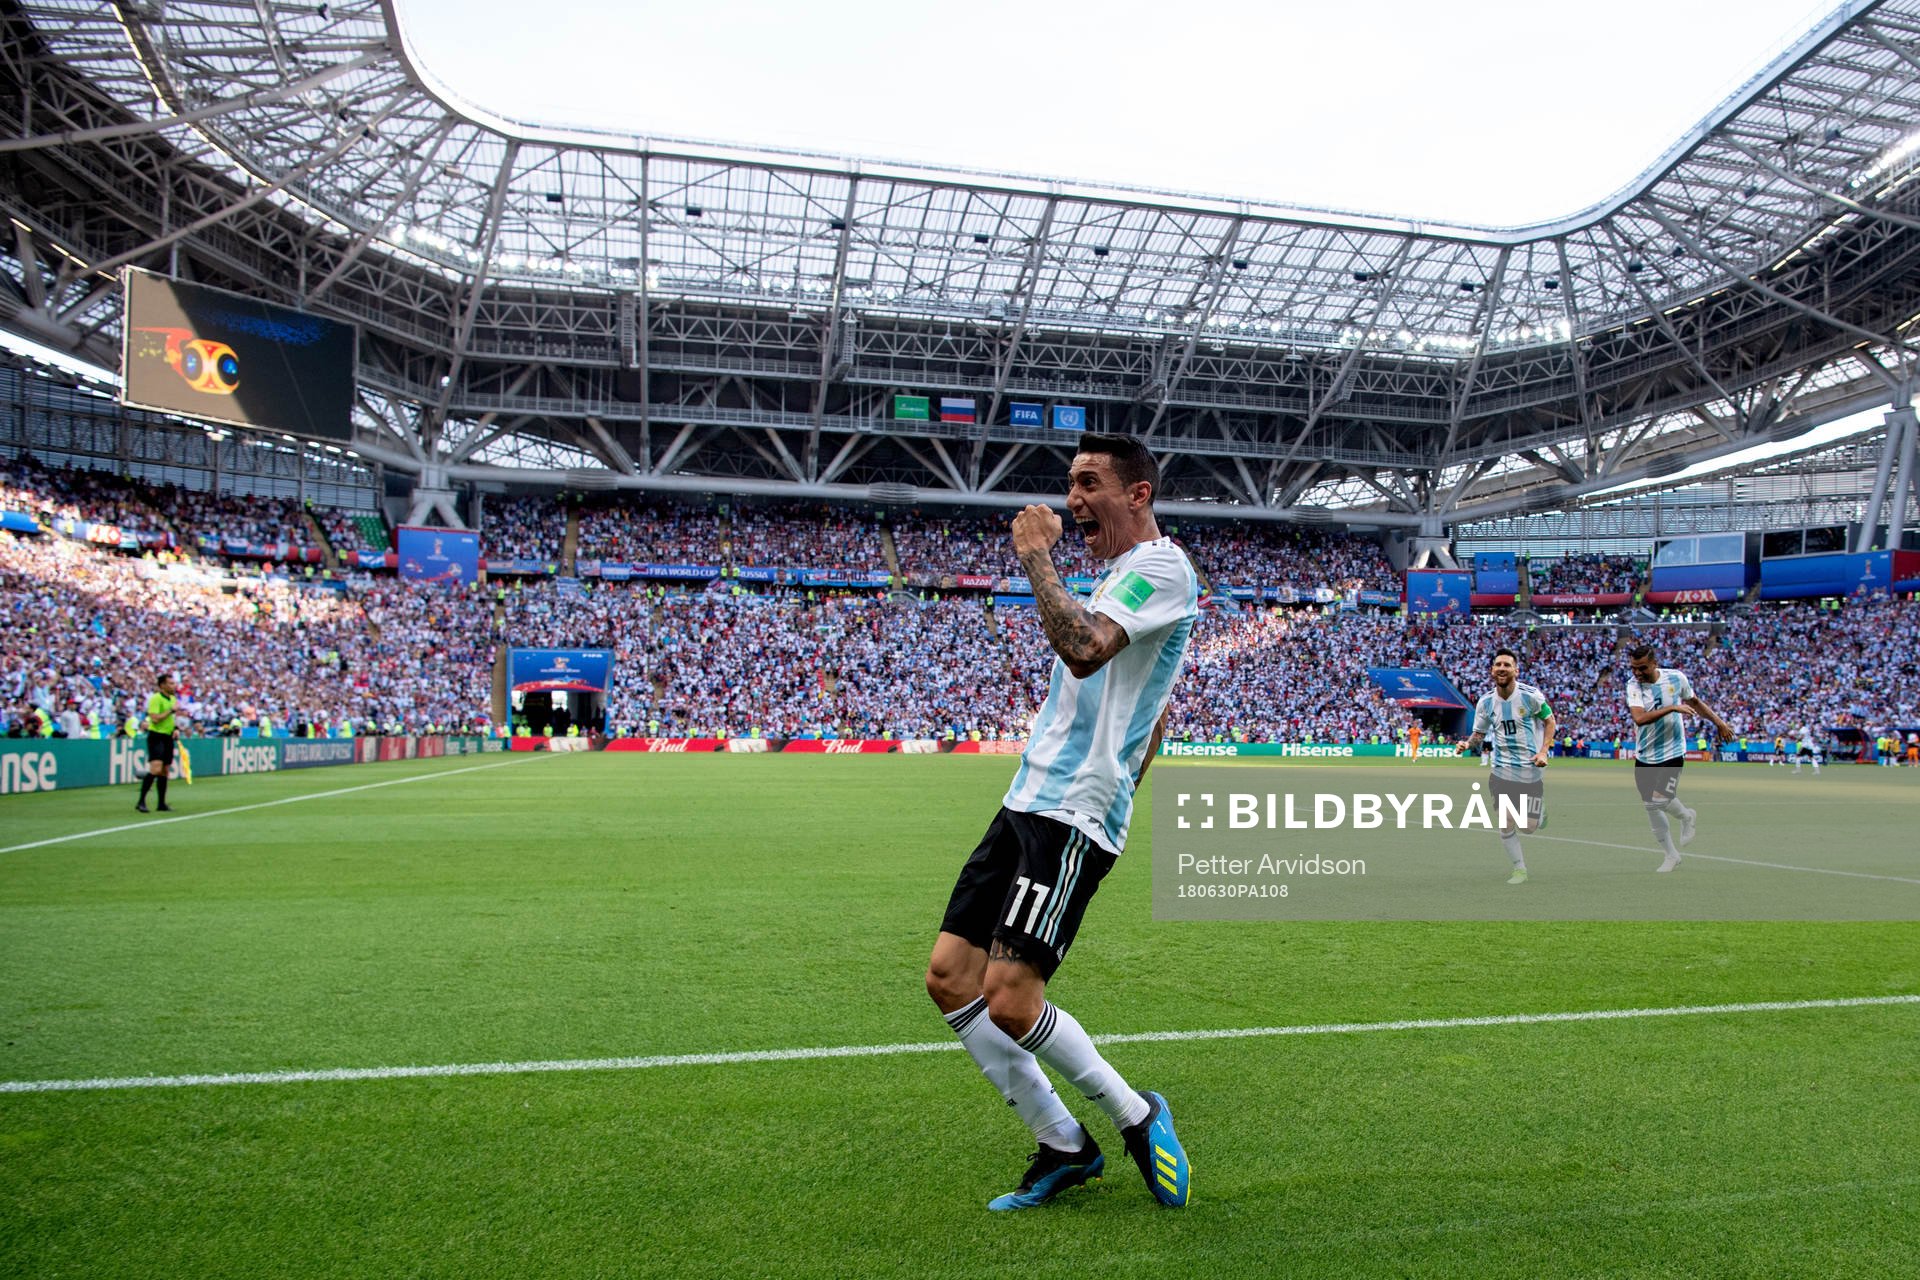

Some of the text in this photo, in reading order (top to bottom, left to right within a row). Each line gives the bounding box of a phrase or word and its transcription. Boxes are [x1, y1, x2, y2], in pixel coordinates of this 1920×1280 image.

[1014, 409, 1038, 420] FIFA
[651, 567, 668, 575] FIFA
[668, 567, 699, 576] WORLD
[700, 568, 719, 577] CUP
[738, 570, 769, 579] RUSSIA
[962, 578, 992, 586] KAZAN
[1500, 719, 1517, 736] 10
[645, 737, 690, 752] Bud
[822, 739, 864, 753] Bud
[1162, 741, 1238, 756] Hisense
[1281, 743, 1353, 757] Hisense
[222, 737, 277, 775] Hisense
[1721, 751, 1738, 761] VISA
[1665, 776, 1676, 793] 2
[1004, 876, 1051, 935] 11
